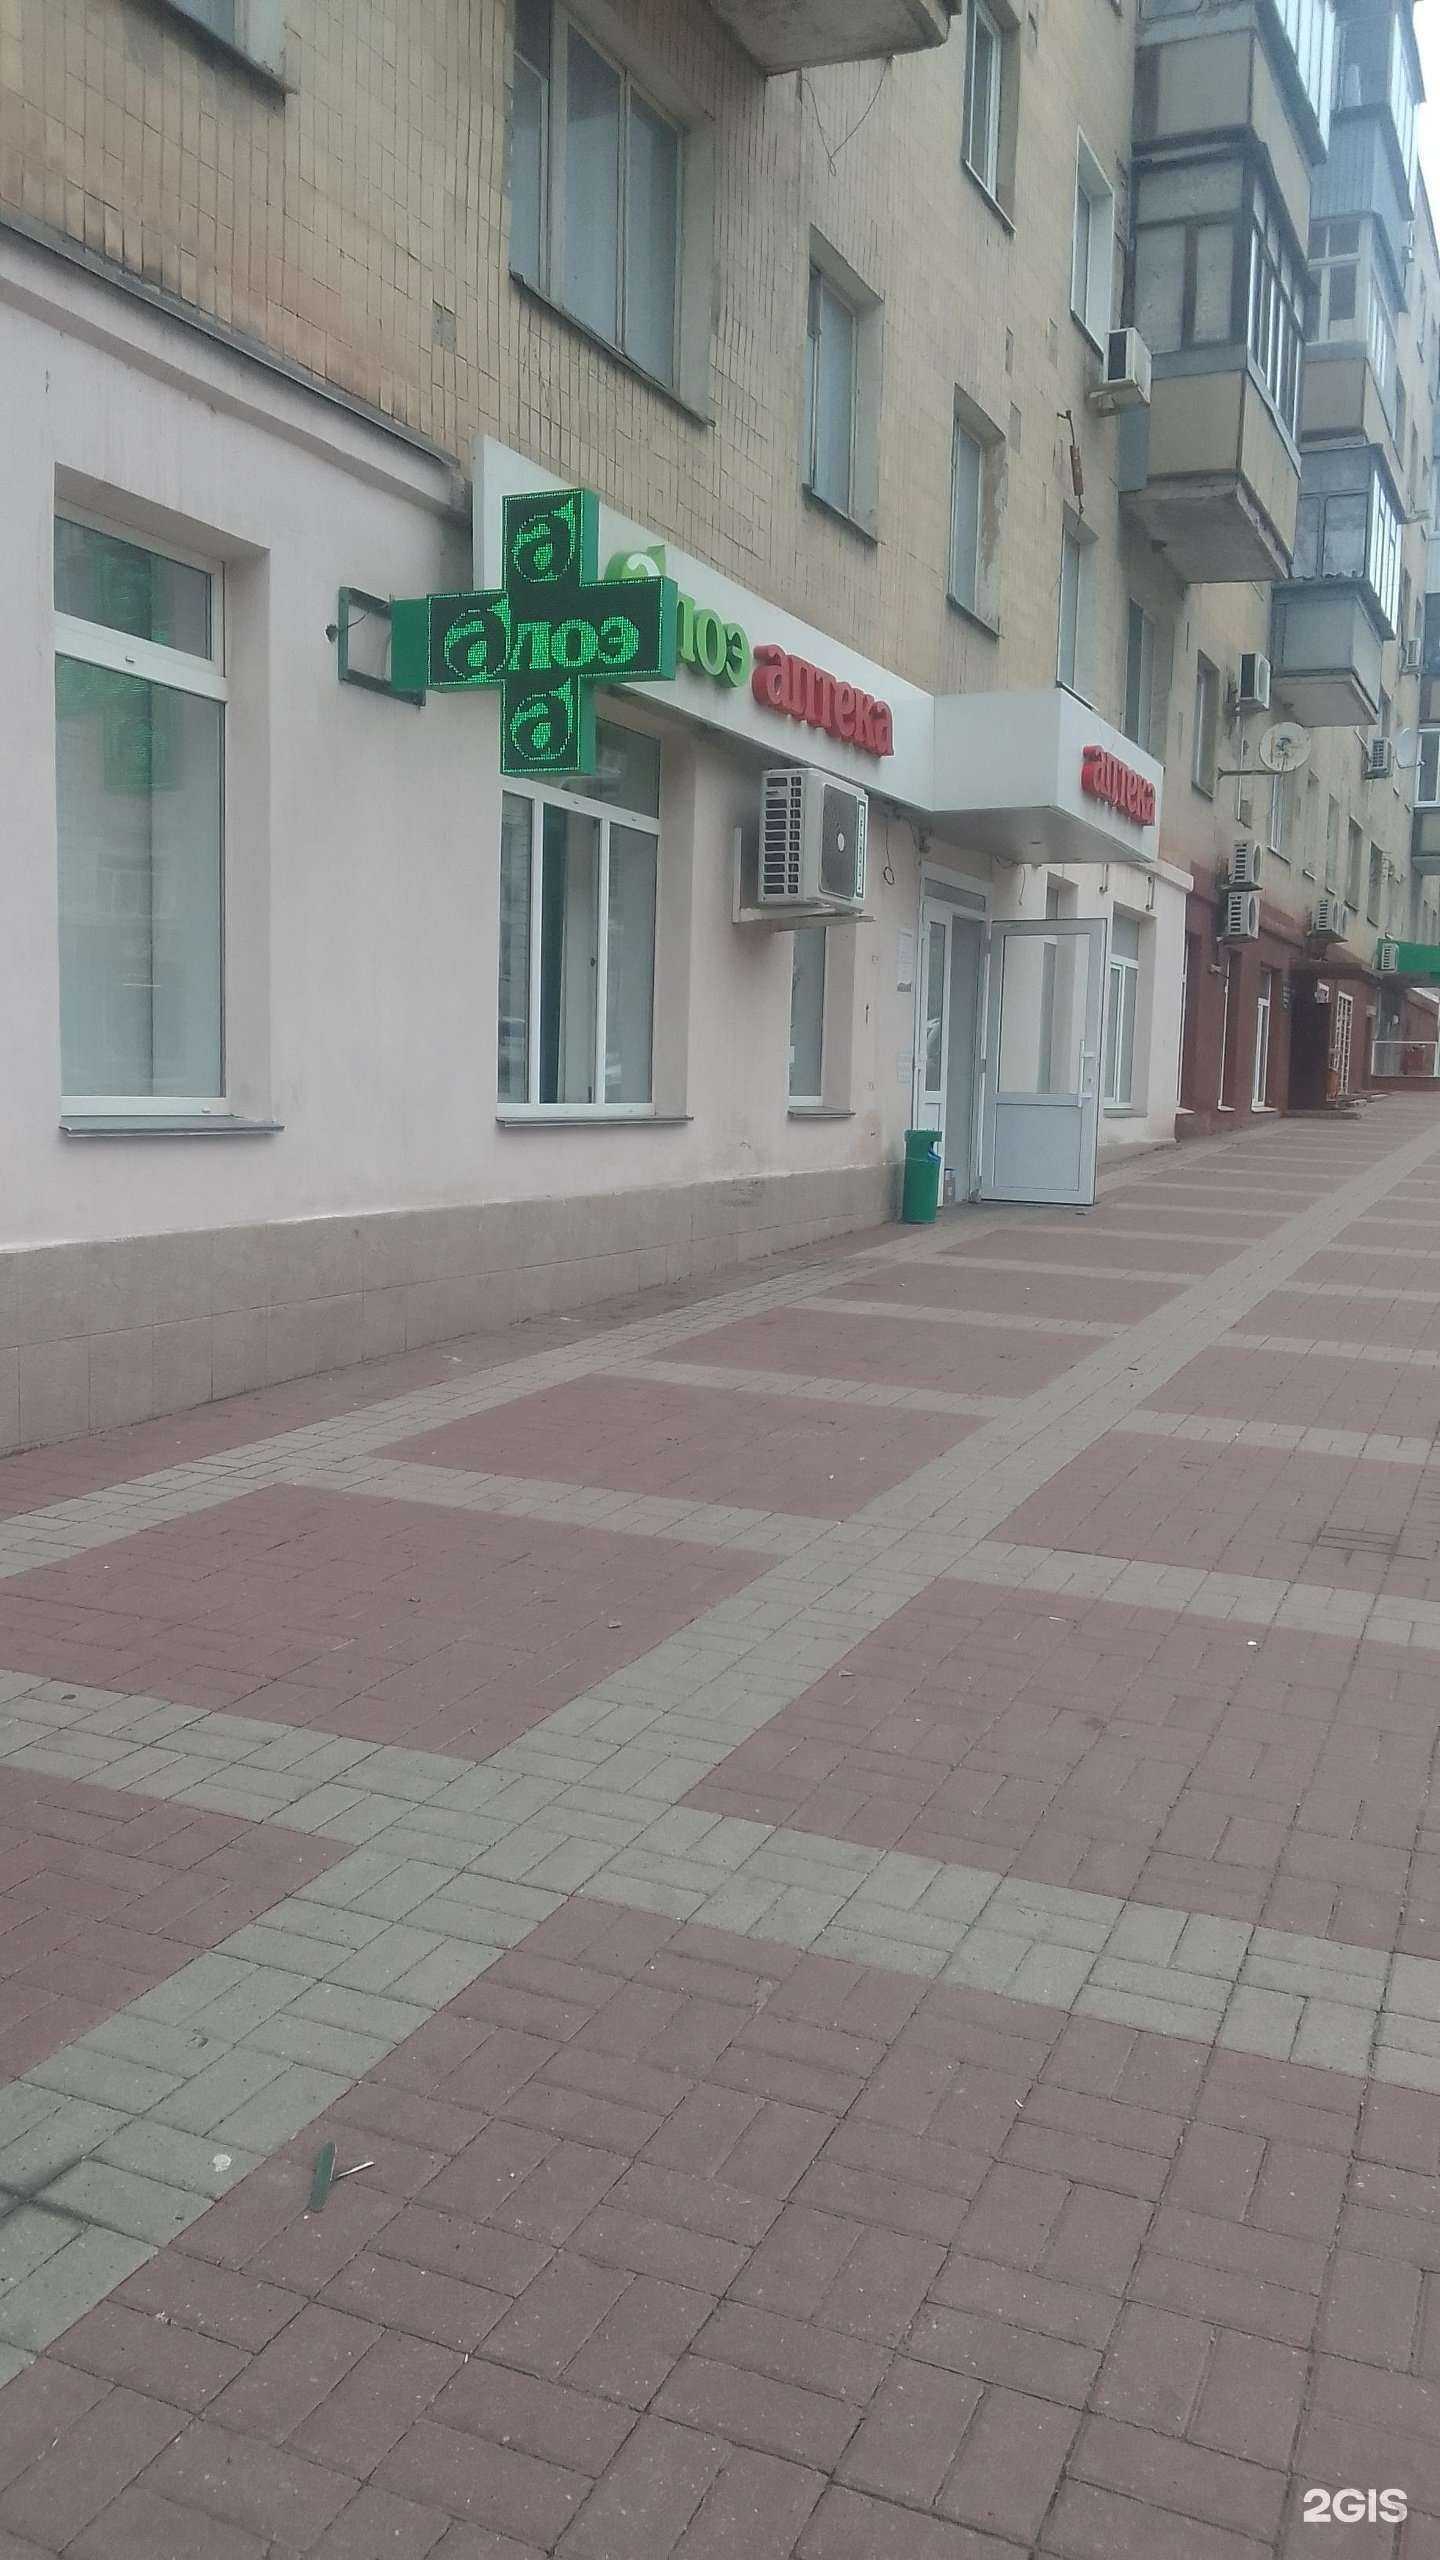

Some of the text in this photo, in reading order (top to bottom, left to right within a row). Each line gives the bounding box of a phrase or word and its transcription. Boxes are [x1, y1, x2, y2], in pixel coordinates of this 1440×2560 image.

[444, 597, 641, 683] алоэ
[752, 644, 895, 757] аптека
[1081, 745, 1156, 825] аптека
